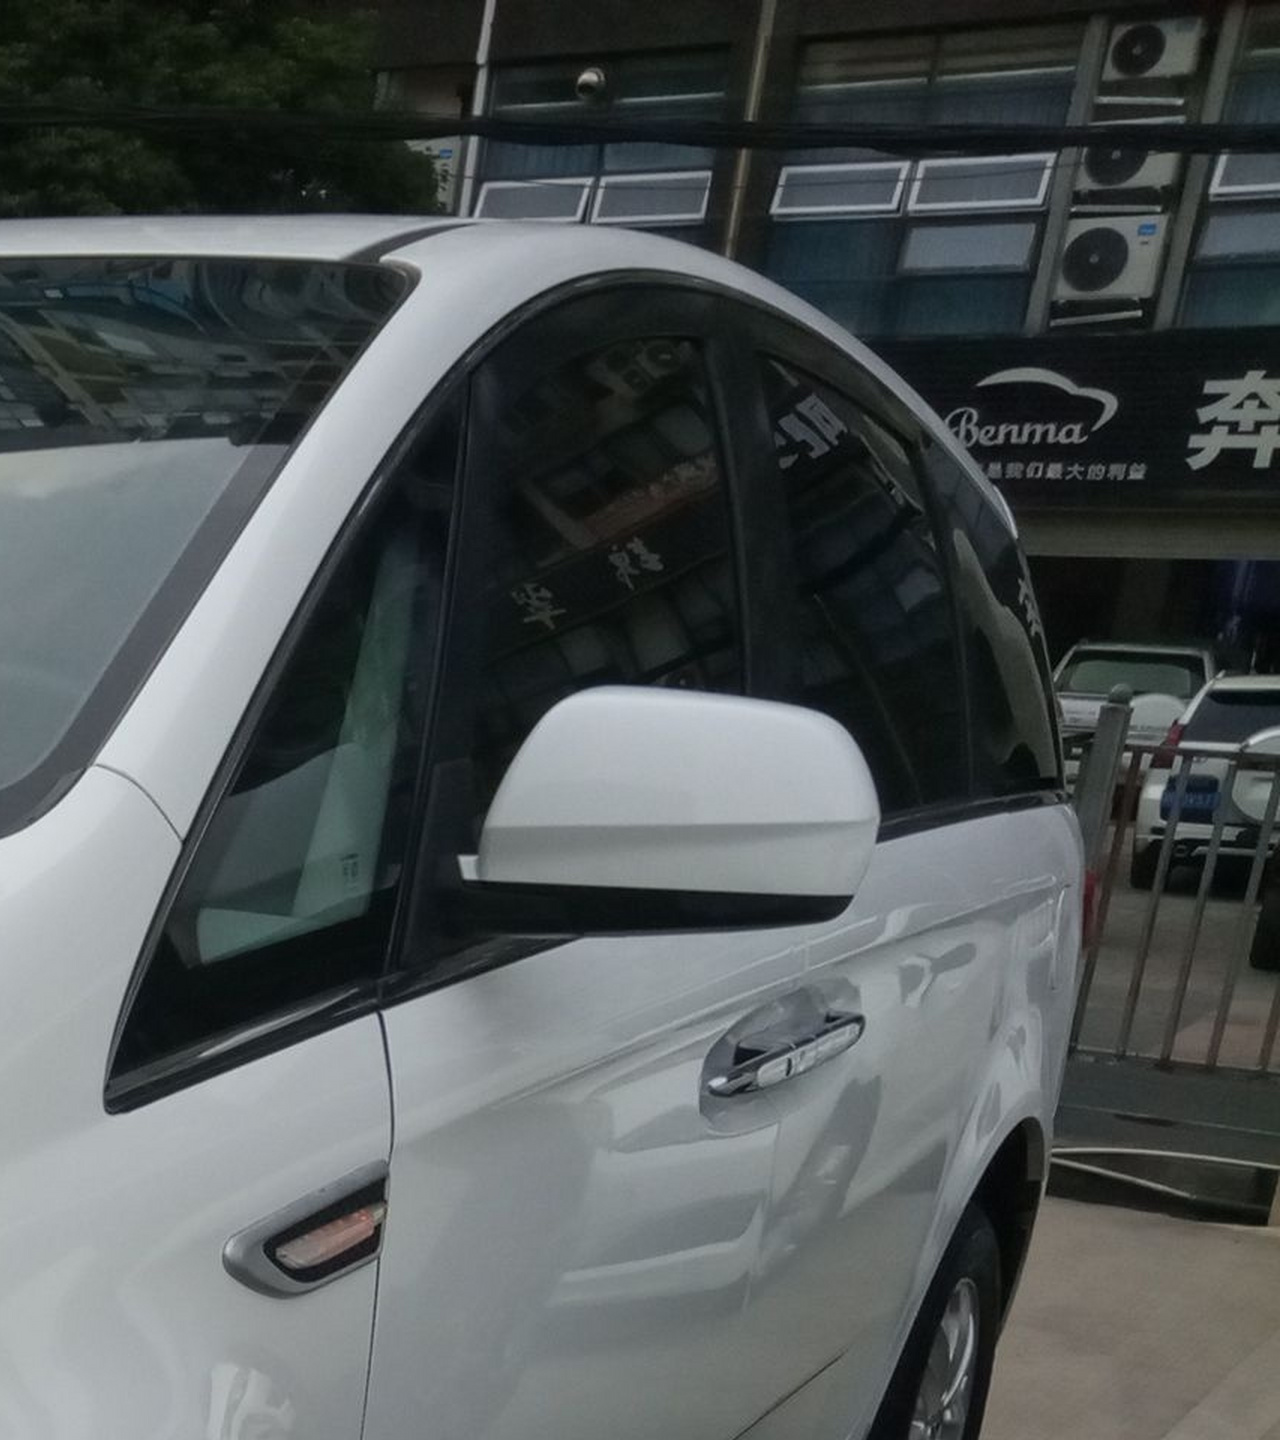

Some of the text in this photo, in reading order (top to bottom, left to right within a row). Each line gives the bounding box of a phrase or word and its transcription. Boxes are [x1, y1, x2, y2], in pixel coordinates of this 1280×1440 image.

[943, 407, 1088, 447] Benma
[1186, 370, 1280, 470] 奔
[981, 462, 1146, 480] 是我们最大的利益
